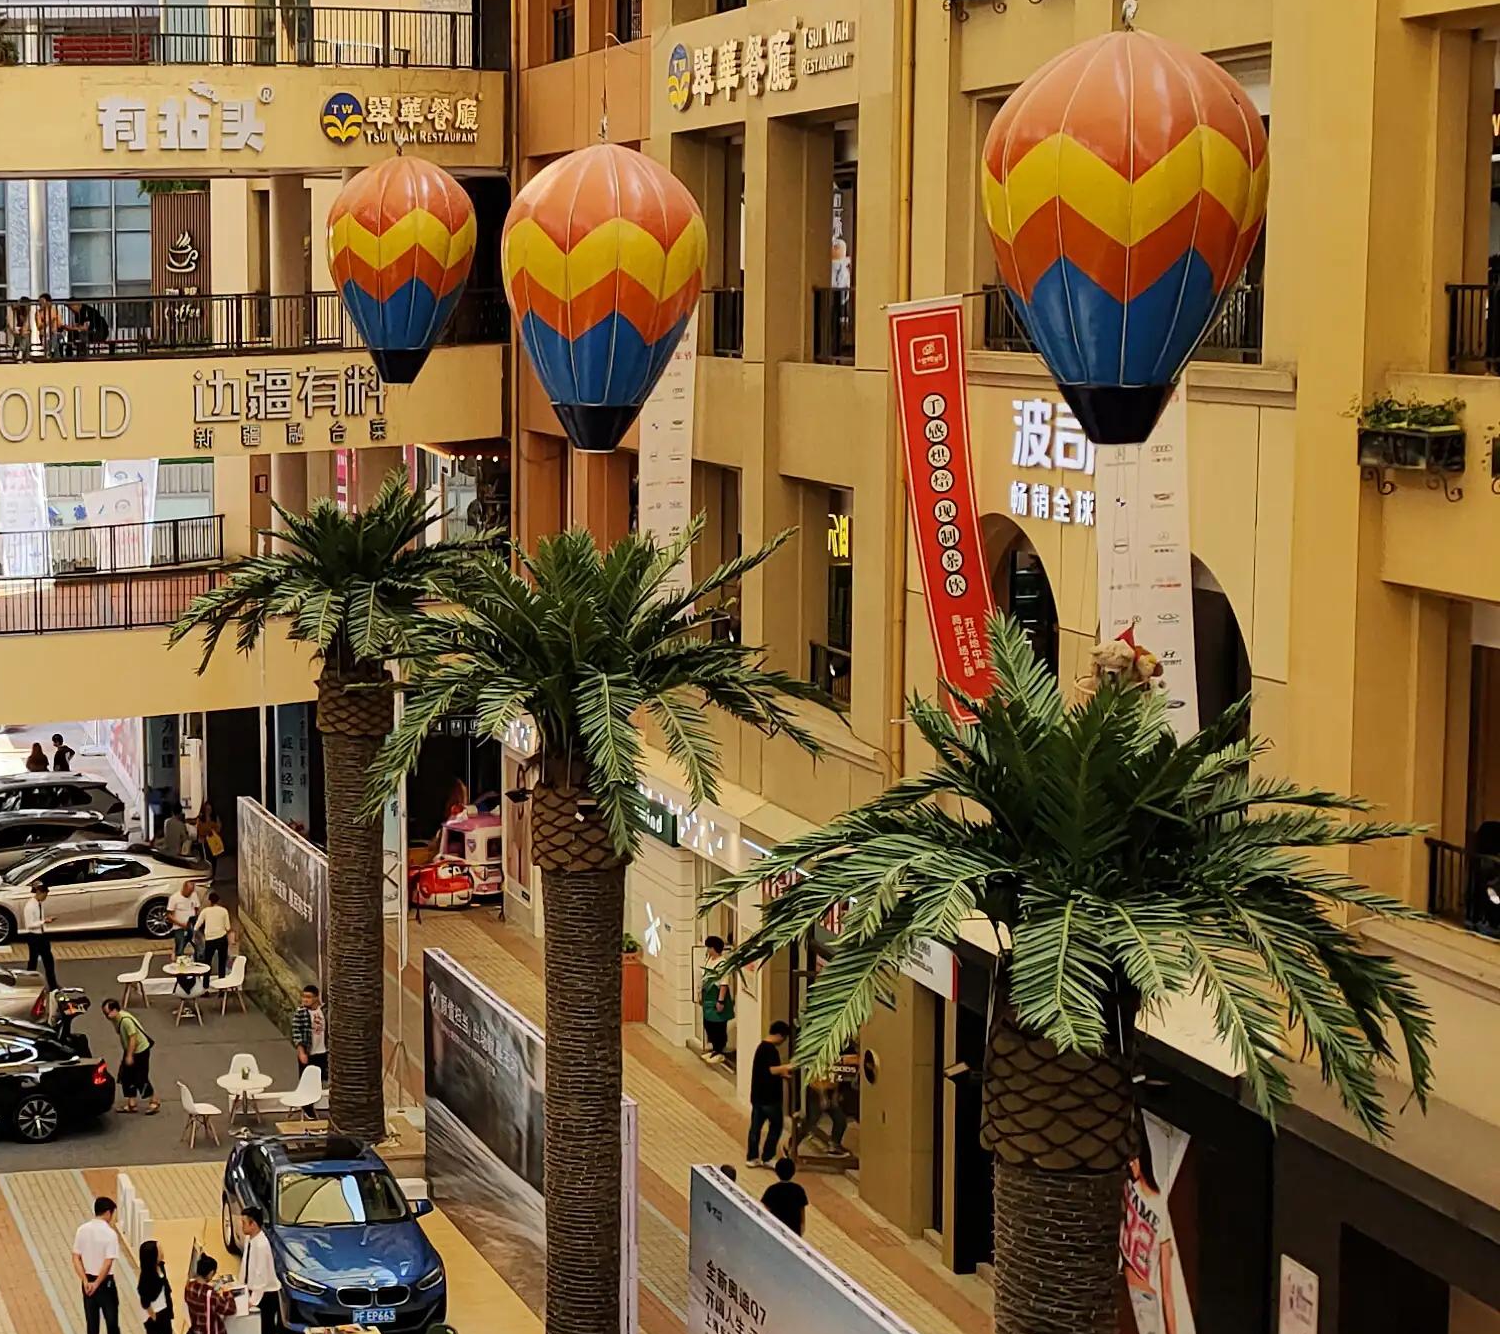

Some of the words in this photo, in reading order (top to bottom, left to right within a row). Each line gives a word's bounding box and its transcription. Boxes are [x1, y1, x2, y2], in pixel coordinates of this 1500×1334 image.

[802, 25, 823, 50] TSUI
[825, 20, 851, 45] WAH
[801, 51, 851, 76] RESTAURANT
[364, 129, 390, 144] TSUI
[419, 129, 479, 144] RESTAURANT
[193, 364, 387, 423] 边疆有料
[1010, 480, 1096, 527] 畅销全球
[706, 1259, 766, 1326] 全新奥迪Q7
